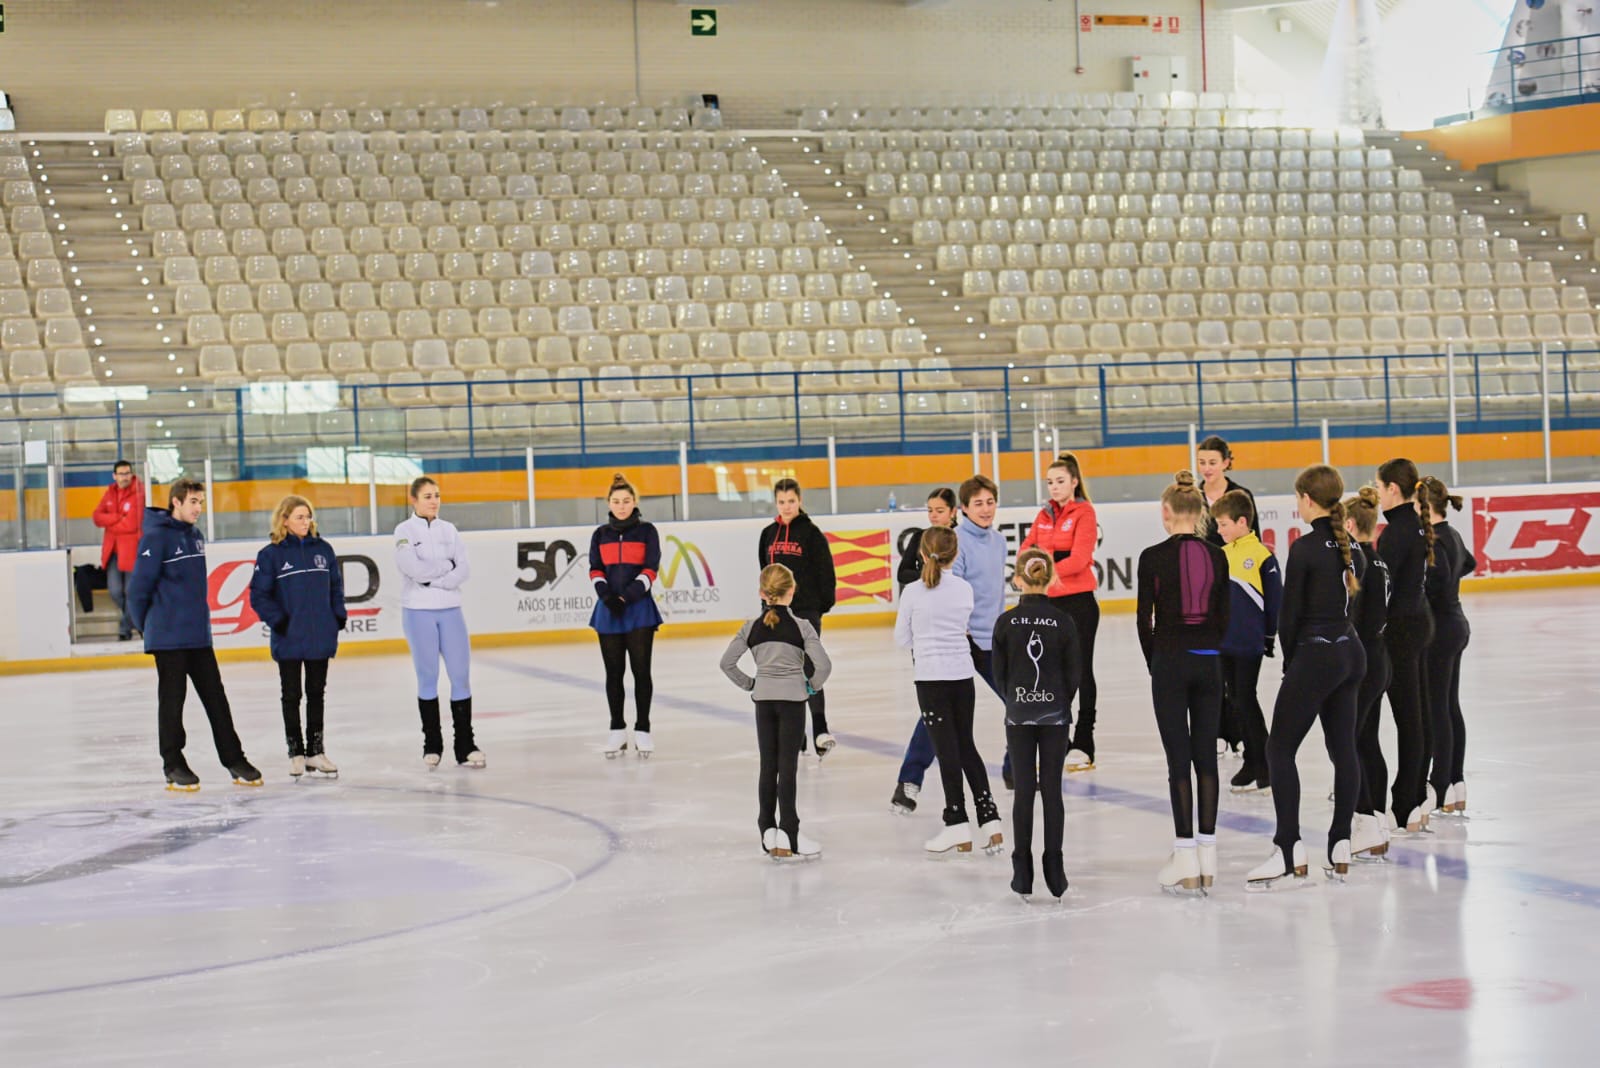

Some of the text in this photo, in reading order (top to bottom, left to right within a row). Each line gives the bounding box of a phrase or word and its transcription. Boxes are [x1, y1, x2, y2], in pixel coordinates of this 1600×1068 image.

[514, 539, 577, 592] 50
[517, 596, 593, 612] AÑOS DE HIELO
[1010, 617, 1058, 628] C. H. JACA
